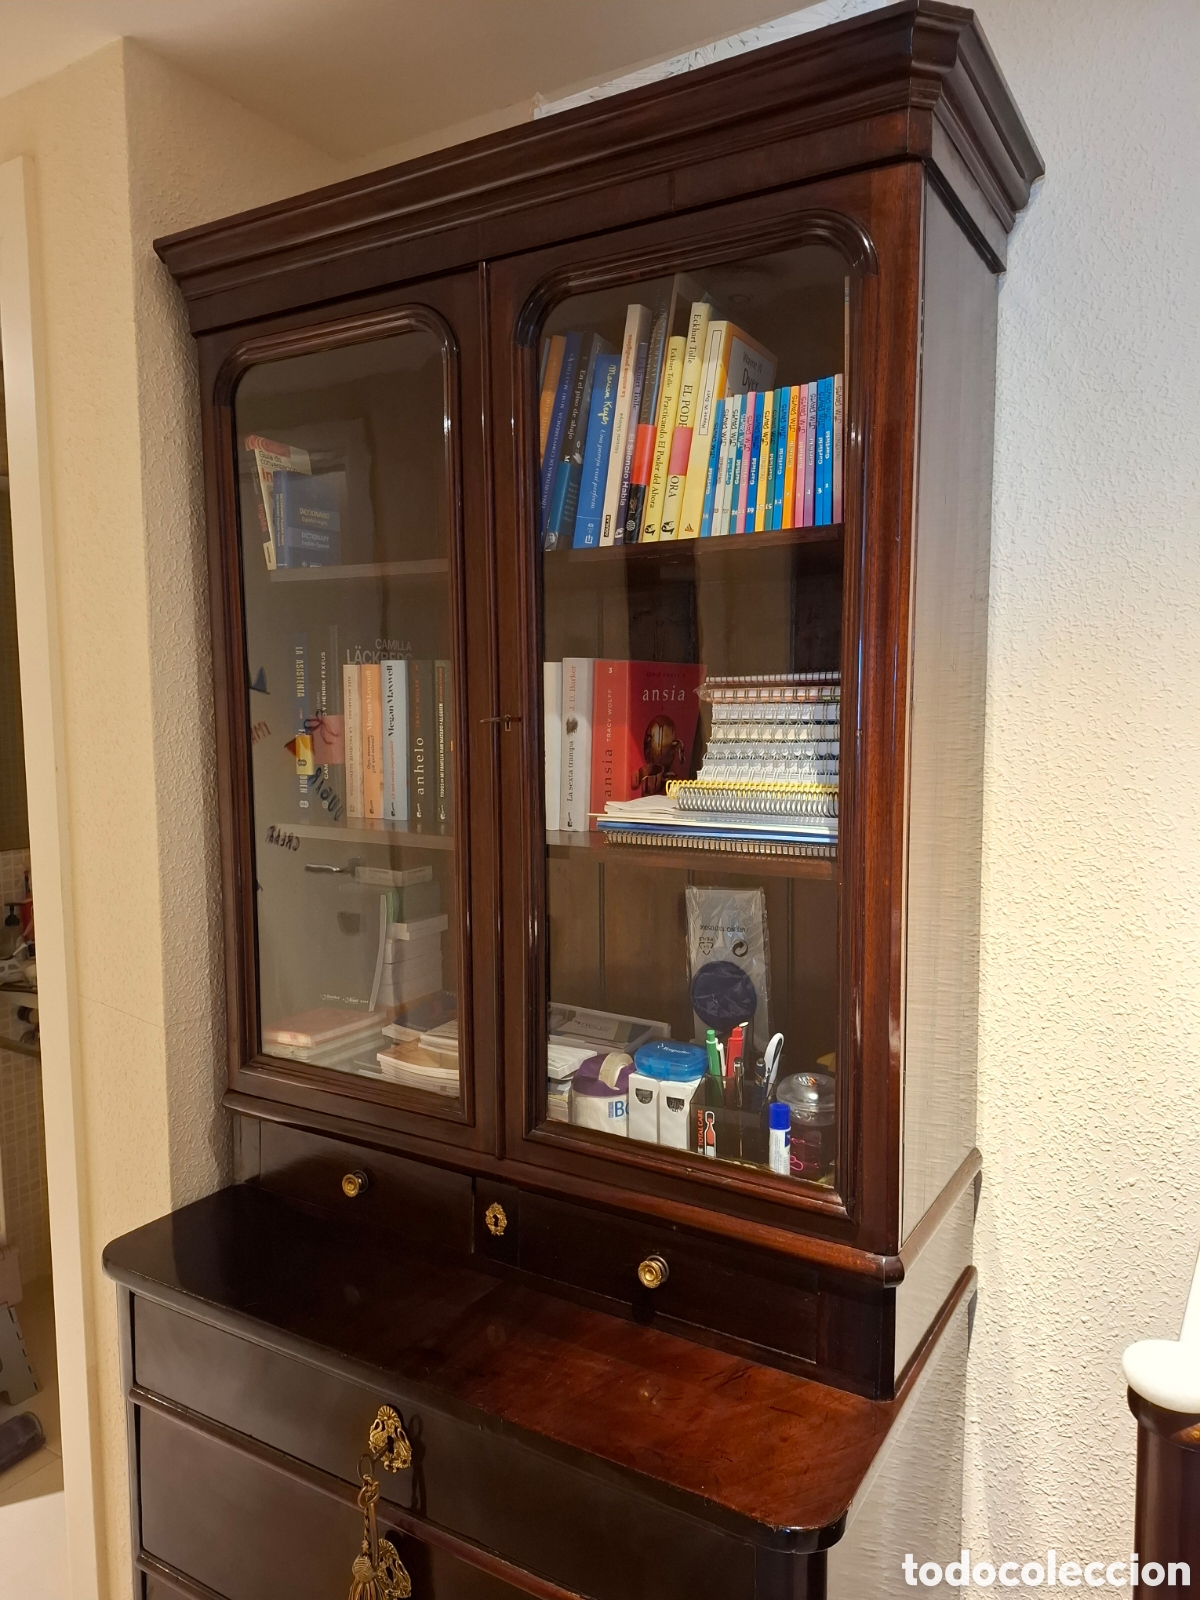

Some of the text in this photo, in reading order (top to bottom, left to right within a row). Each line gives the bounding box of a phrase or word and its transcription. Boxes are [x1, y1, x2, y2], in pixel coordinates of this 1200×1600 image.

[687, 314, 701, 364] Eckhart Tolle
[669, 348, 677, 371] Eckhart
[577, 382, 583, 390] el
[579, 370, 586, 380] En
[605, 364, 616, 399] Marian
[633, 392, 641, 411] Tolle
[683, 384, 693, 397] EL
[572, 408, 579, 418] de
[597, 401, 613, 425] Keyes
[568, 419, 576, 440] abajo
[649, 396, 672, 509] Practicando El Poder del Ahora
[620, 433, 635, 506] El Silencio Habla
[590, 481, 598, 509] perfecta
[669, 475, 679, 498] ORA
[299, 507, 330, 520] DICCIONARIO
[301, 532, 330, 542] DICTIONARY
[295, 647, 303, 655] LA
[375, 638, 412, 652] CAMILLA
[295, 659, 305, 698] ASISTENTA
[569, 665, 577, 692] Barker
[365, 670, 373, 731] Megan Maxwell
[386, 665, 395, 737] Megan Maxwell
[642, 685, 686, 701] ansia
[414, 737, 425, 795] anhelo
[602, 748, 613, 798] ansia
[567, 790, 573, 802] La
